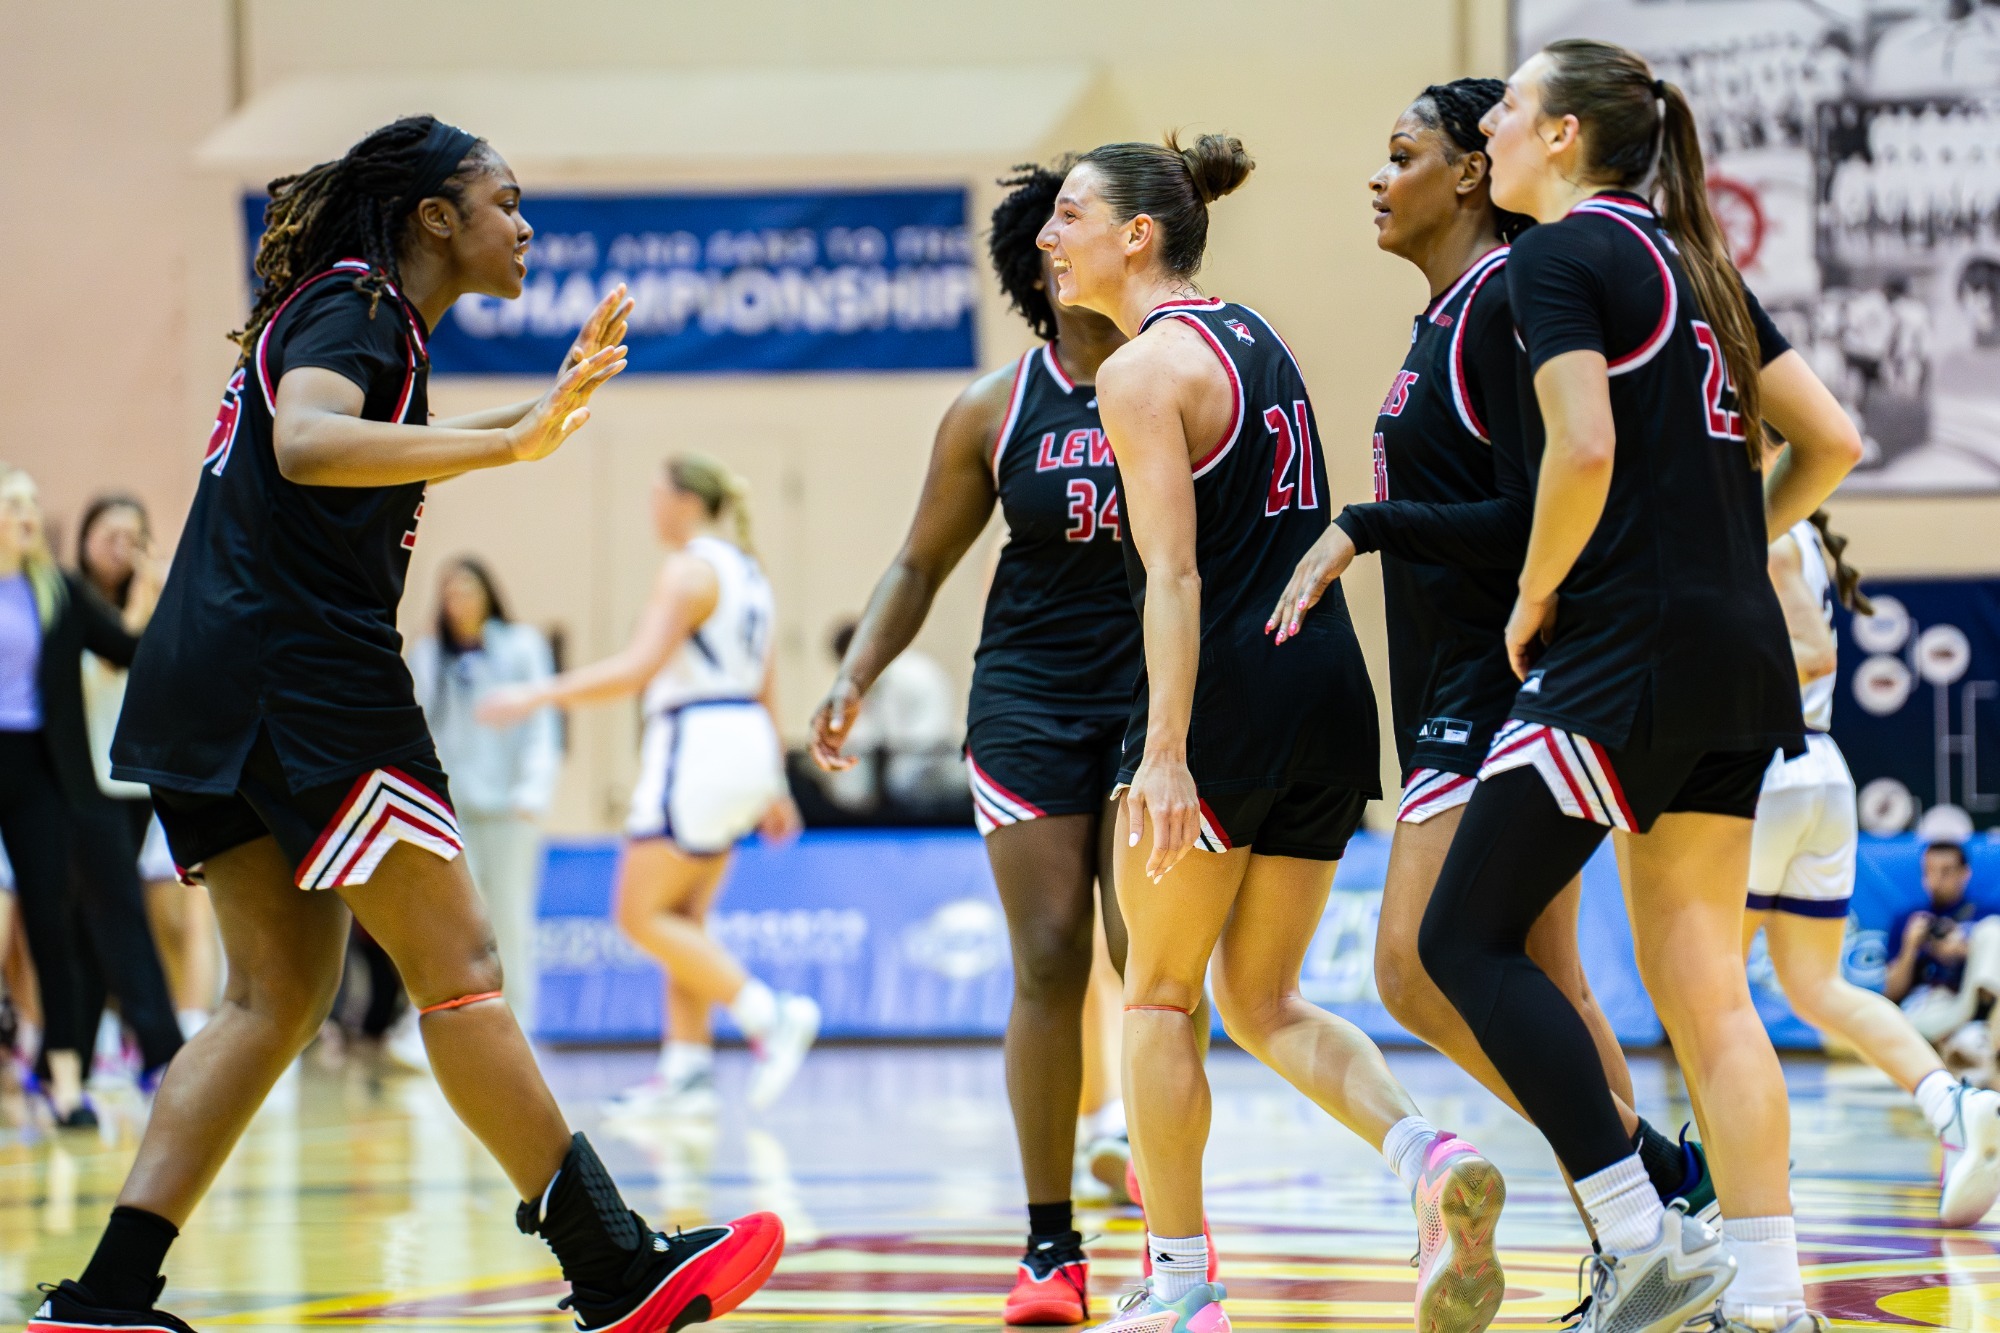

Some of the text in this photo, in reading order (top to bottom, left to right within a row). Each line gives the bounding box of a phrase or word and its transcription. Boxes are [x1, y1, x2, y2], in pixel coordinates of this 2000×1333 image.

[1035, 427, 1115, 473] LEW
[1263, 400, 1318, 517] 21
[1065, 478, 1122, 543] 34
